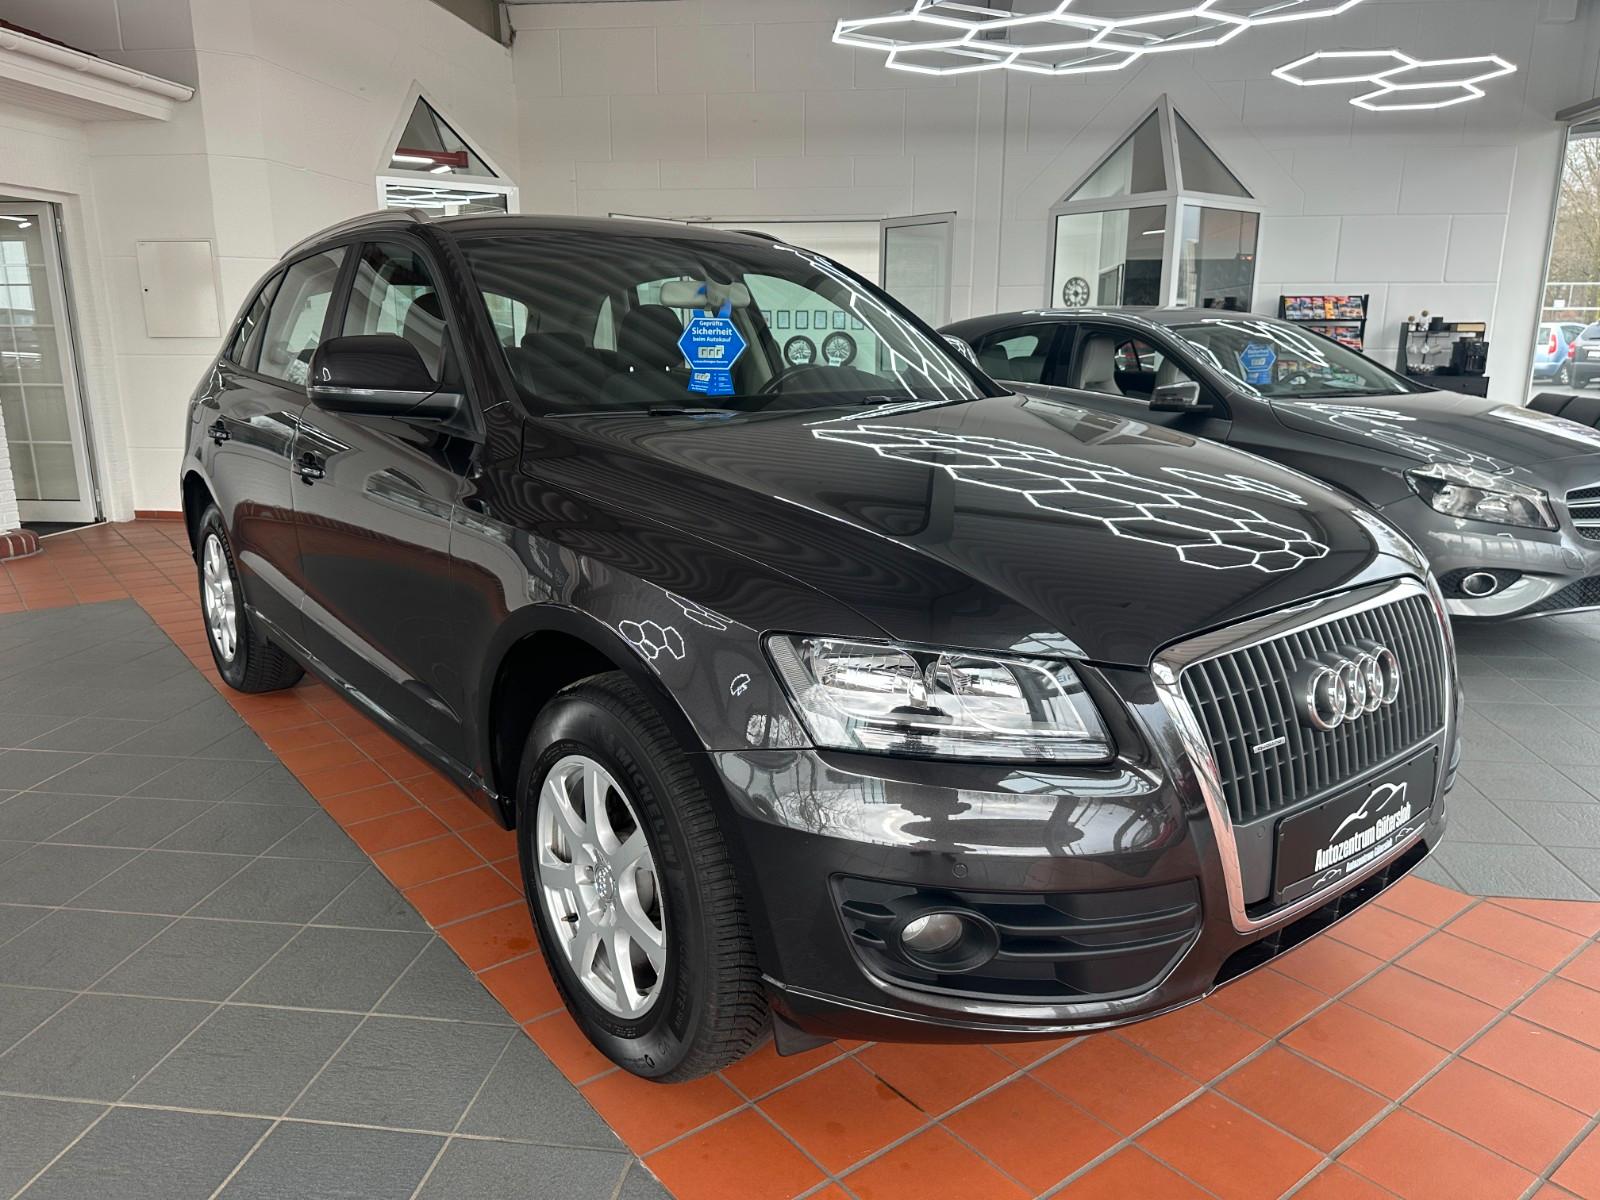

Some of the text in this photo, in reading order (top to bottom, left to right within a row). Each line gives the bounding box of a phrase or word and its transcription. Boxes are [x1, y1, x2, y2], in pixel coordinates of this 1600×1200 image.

[691, 327, 733, 336] Sicherheit
[615, 746, 679, 863] MICHELIN
[1314, 801, 1412, 873] Autozentrum Gütersloh
